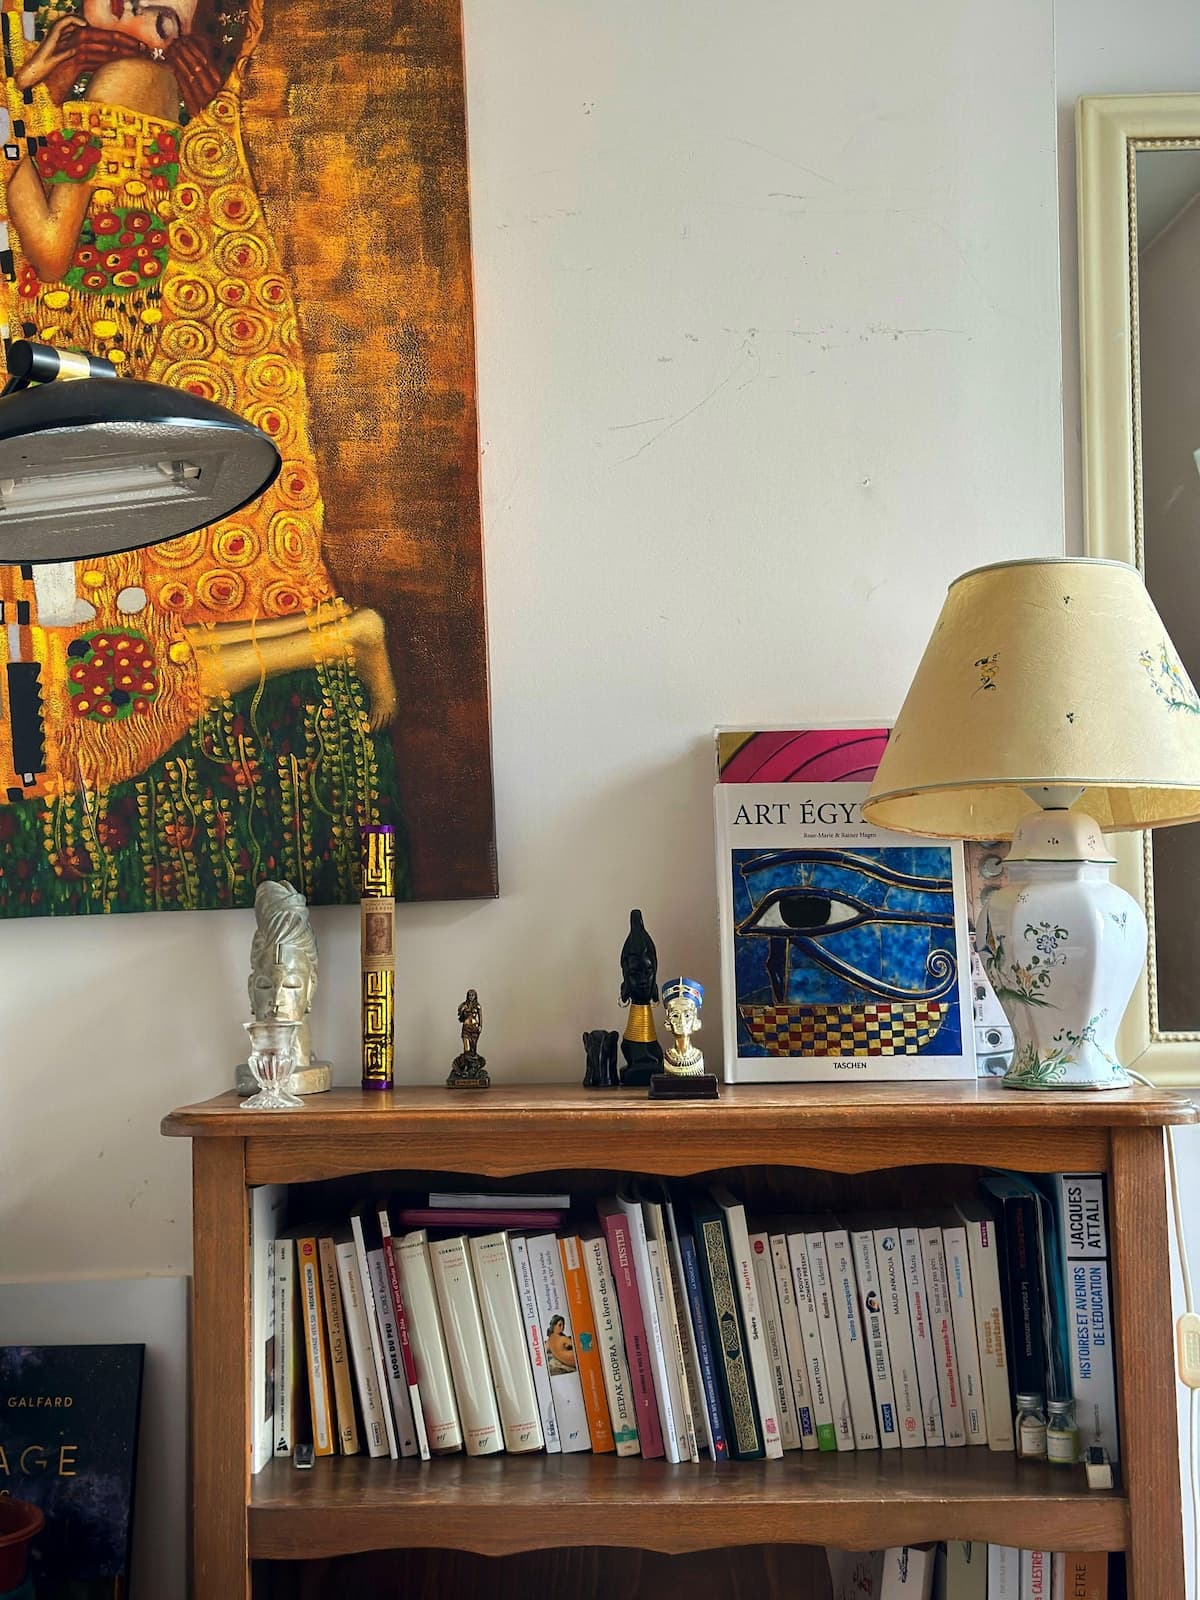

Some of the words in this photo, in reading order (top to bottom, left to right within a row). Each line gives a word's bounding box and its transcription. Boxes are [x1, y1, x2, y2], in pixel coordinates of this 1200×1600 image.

[733, 803, 790, 824] ART
[833, 1062, 867, 1070] TASCHEN
[1068, 1187, 1085, 1250] JACQUES
[1085, 1199, 1101, 1249] ATTALI
[593, 1243, 604, 1276] secrets
[615, 1228, 628, 1267] EINSTEIN
[800, 1252, 809, 1277] PRÉSENT
[839, 1257, 848, 1273] Saga
[888, 1257, 897, 1292] ANKAOUA
[909, 1255, 918, 1274] Maria
[928, 1258, 937, 1271] péri
[599, 1278, 608, 1295] des
[796, 1267, 805, 1293] POUVOIR
[804, 1278, 813, 1303] MOMENT
[1073, 1267, 1088, 1311] AVENIRS
[602, 1297, 611, 1318] livre
[807, 1304, 814, 1313] DU
[821, 1292, 831, 1319] Kundera
[842, 1278, 854, 1319] Benacquista
[892, 1293, 900, 1315] MAUD
[385, 1323, 393, 1338] PEU
[604, 1319, 613, 1331] Le
[1076, 1312, 1088, 1325] ET
[388, 1340, 395, 1352] DU
[531, 1324, 539, 1346] Camus
[1023, 1321, 1033, 1357] amoureux
[1093, 1333, 1105, 1346] DE
[334, 1338, 344, 1364] Kafka
[534, 1347, 542, 1367] Albert
[609, 1344, 621, 1382] CHOPRA
[1077, 1327, 1091, 1379] HISTOIRES
[812, 1357, 821, 1376] TOLLE
[615, 1383, 628, 1419] DEEPAK
[815, 1377, 825, 1405] ECKHART
[947, 1369, 957, 1408] Emmanuelle
[7, 1396, 73, 1408] GALFARD
[883, 1405, 892, 1432] POCKET
